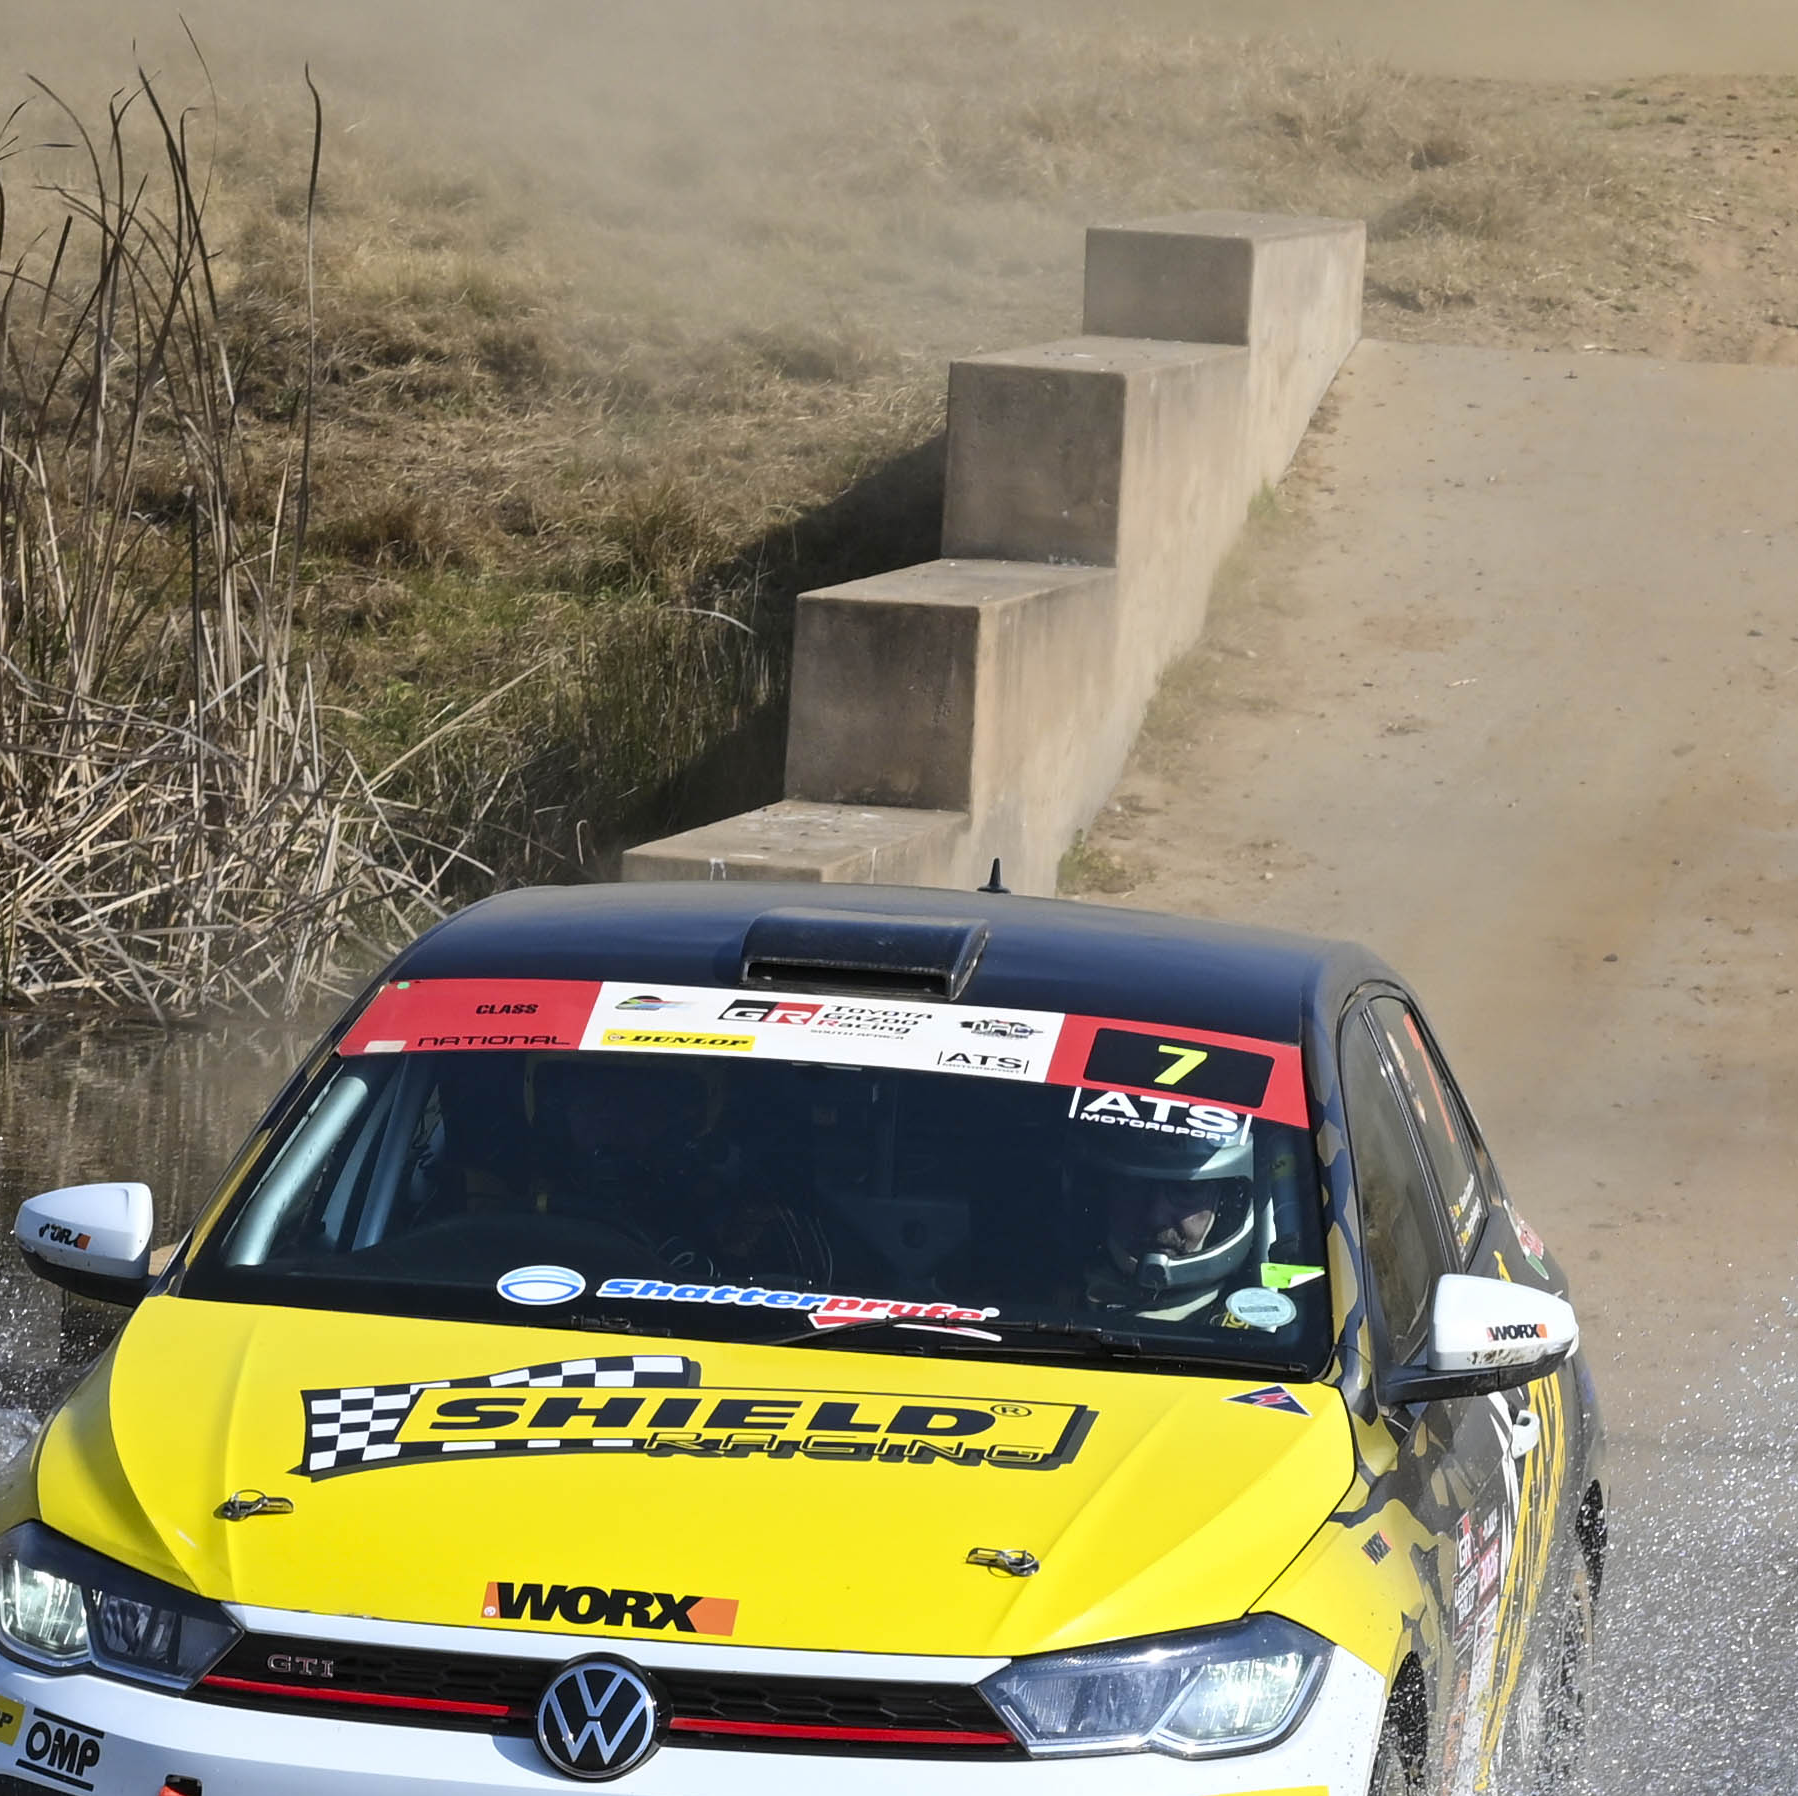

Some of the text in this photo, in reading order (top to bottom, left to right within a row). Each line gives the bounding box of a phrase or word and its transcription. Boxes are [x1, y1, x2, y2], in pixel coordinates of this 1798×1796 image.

[475, 1003, 539, 1015] CLASS
[830, 1004, 933, 1019] TOYOTA
[417, 1034, 571, 1047] NATIONAL
[630, 1034, 750, 1047] DUNLOP
[944, 1051, 1024, 1070] ATS
[1153, 1044, 1209, 1086] 7
[1082, 1090, 1239, 1134] ATS
[1079, 1111, 1236, 1144] MOTORSPORT
[1488, 1323, 1541, 1341] WORX
[428, 1396, 996, 1437] SHIELD
[643, 1431, 1049, 1468] RACING
[497, 1581, 704, 1633] WORX
[266, 1653, 334, 1679] GTI
[25, 1720, 101, 1777] OMP
